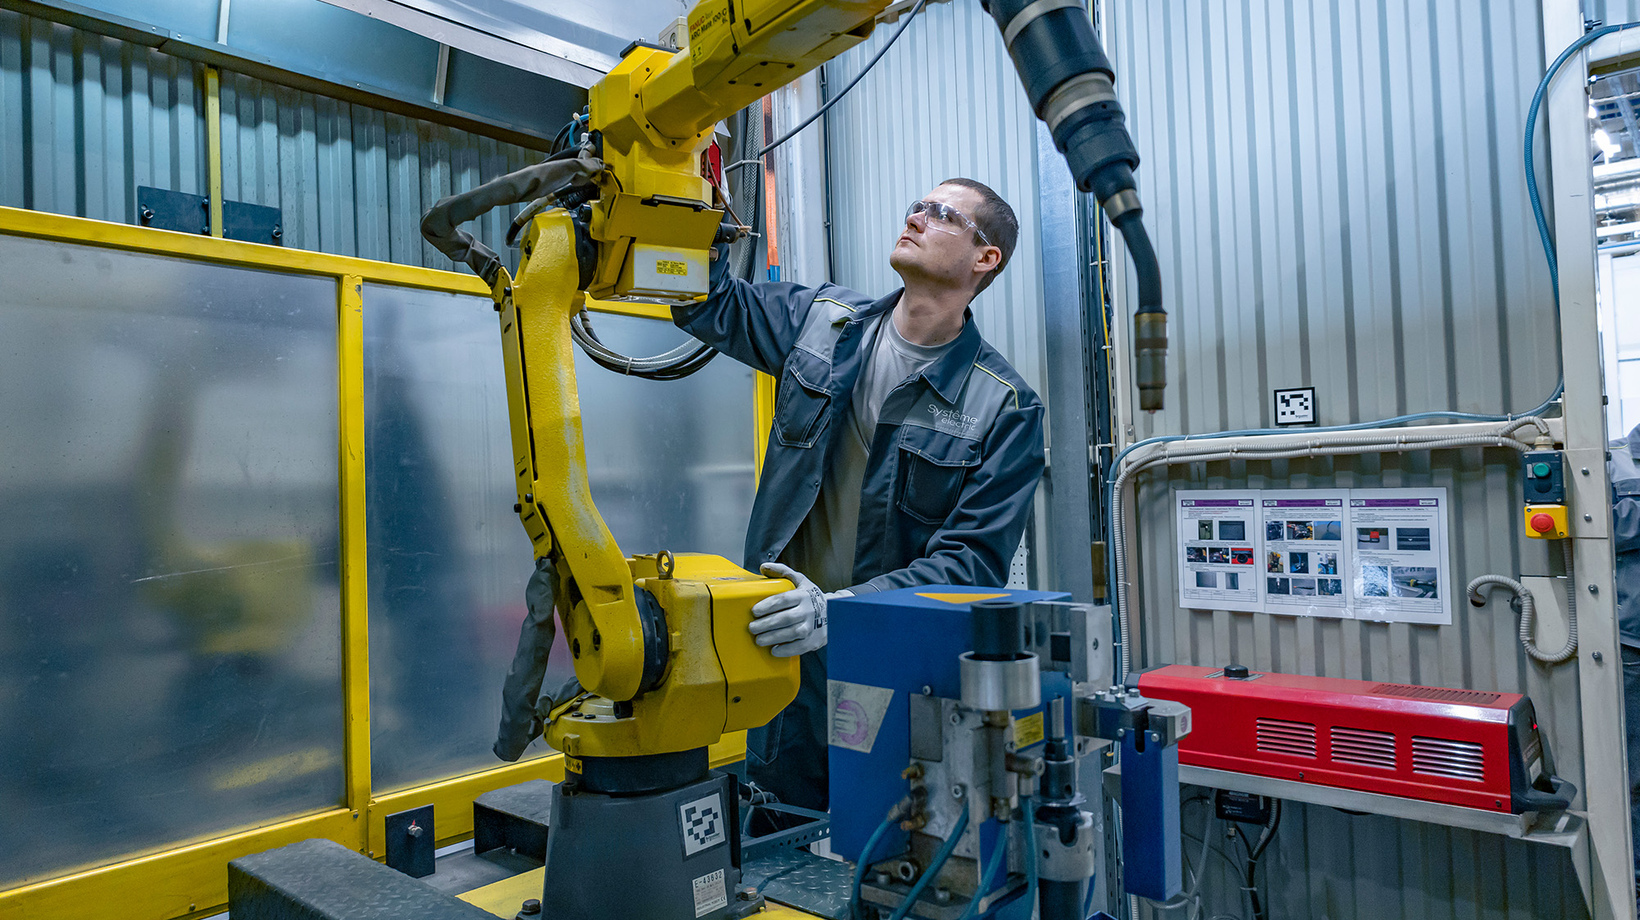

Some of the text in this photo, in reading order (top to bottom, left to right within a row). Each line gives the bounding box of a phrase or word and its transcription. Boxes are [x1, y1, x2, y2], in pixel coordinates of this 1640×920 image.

[690, 16, 705, 32] FANUC
[691, 28, 701, 40] ARC
[941, 417, 976, 431] electric
